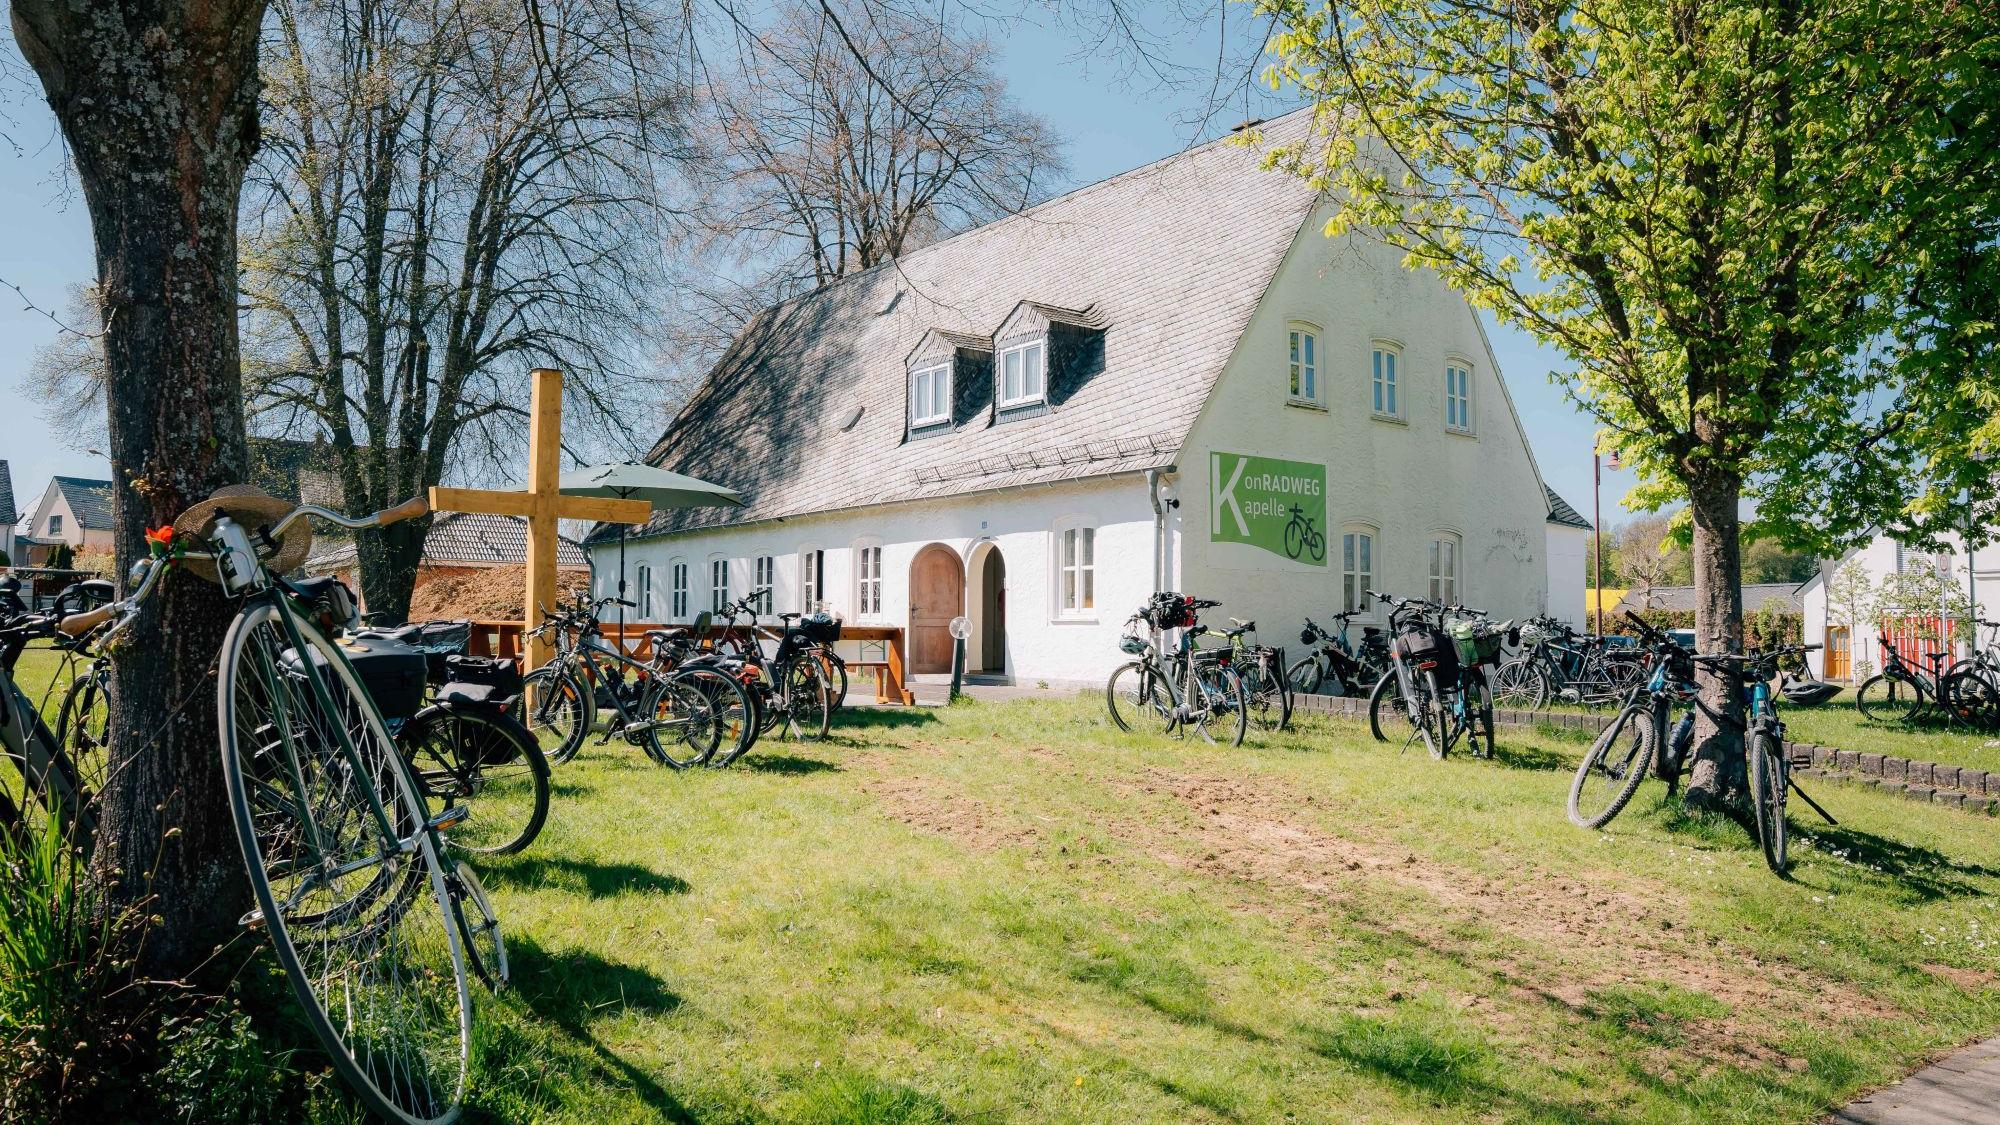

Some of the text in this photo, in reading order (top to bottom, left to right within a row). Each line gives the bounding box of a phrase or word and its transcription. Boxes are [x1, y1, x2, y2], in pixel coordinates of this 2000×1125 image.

[1212, 454, 1251, 537] K
[1245, 473, 1320, 496] onRADWEG
[1244, 497, 1285, 519] apelle
